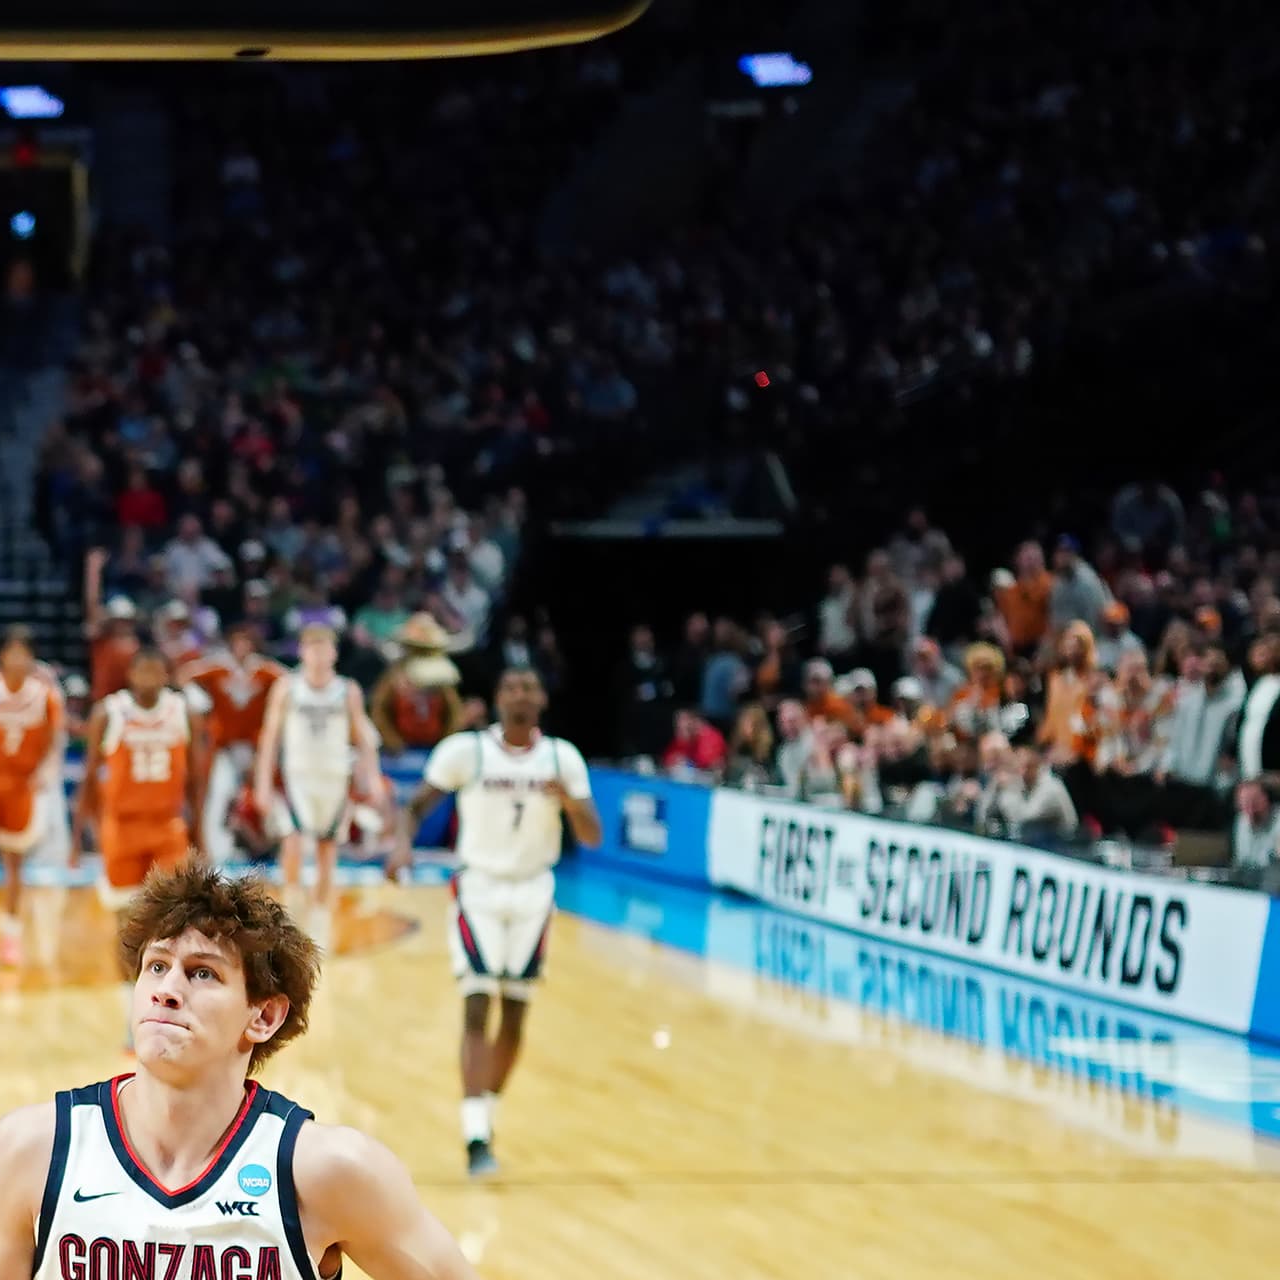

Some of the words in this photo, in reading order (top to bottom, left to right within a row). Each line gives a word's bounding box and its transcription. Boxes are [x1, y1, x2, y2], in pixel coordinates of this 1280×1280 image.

[758, 815, 837, 908] FIRST
[859, 838, 992, 946] SECOND
[1002, 866, 1192, 995] ROUNDS
[242, 1177, 270, 1189] NCAA
[214, 1200, 261, 1216] WCC
